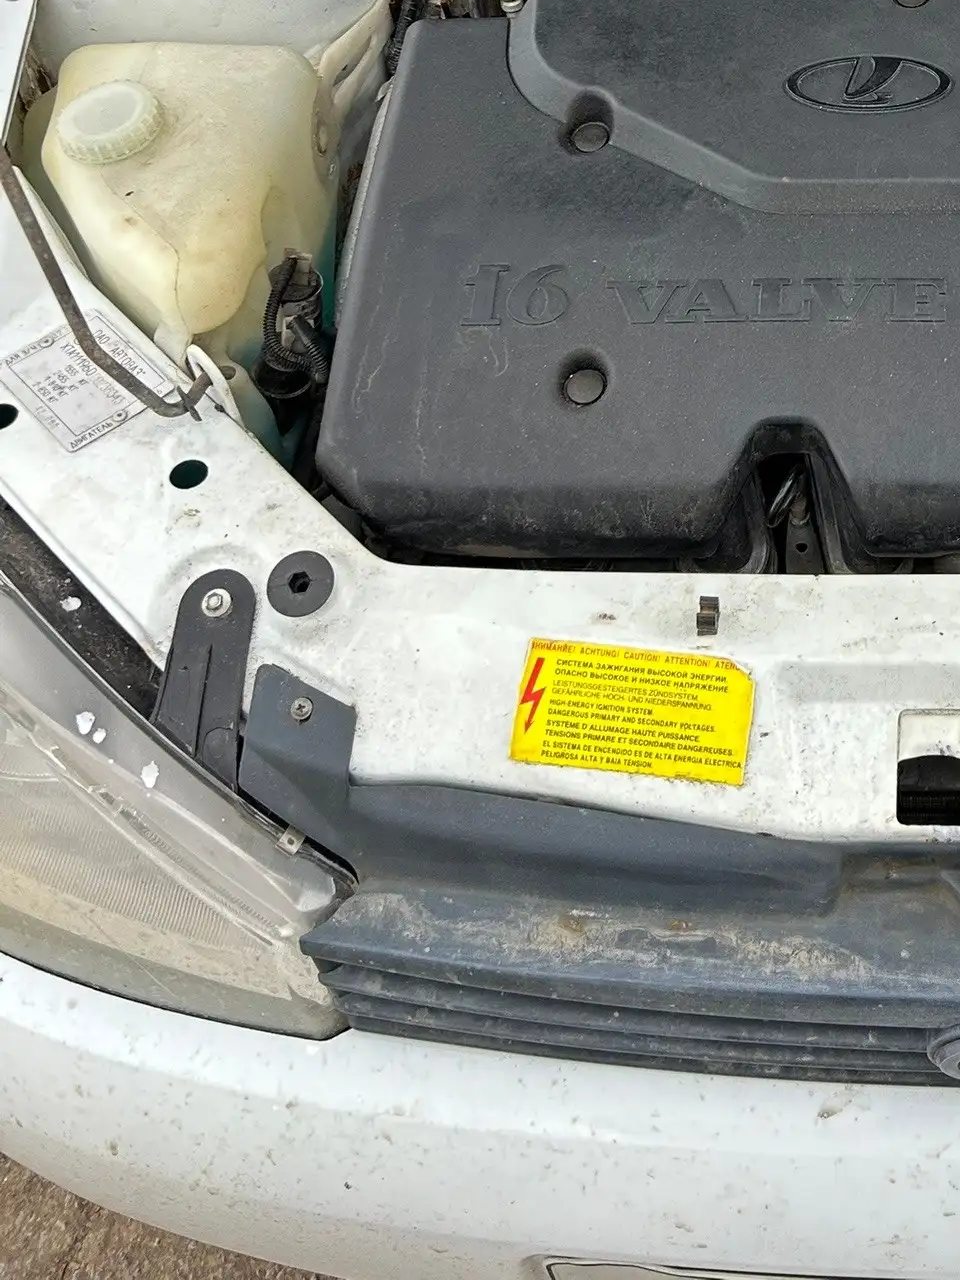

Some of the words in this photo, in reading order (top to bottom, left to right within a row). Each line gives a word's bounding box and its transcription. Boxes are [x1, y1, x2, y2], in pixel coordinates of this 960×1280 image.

[461, 263, 569, 327] 16
[605, 277, 947, 324] VALVE
[556, 657, 593, 669] СИСТЕМА
[595, 662, 645, 675] ЗАЖИГАНИЯ
[646, 668, 687, 680] ВЫСОКОЙ
[579, 646, 619, 658] ACHTUNG!
[623, 651, 661, 663] CAUTION!
[664, 656, 711, 669] ATTENTION!
[552, 677, 647, 696] LEISTUNGSGESTEIGERTES
[554, 666, 588, 678] ОПАСНО
[589, 670, 629, 683] ВЫСОКОЕ
[631, 675, 637, 684] И
[639, 676, 670, 688] НИЗКОЕ
[595, 703, 625, 713] IGNITION
[627, 695, 643, 704] UND
[547, 706, 589, 719] DANGEROUS
[590, 711, 620, 723] PRIMARY
[621, 715, 635, 725] AND
[636, 717, 677, 730] SECONDARY
[544, 727, 581, 739] TENSIONS
[617, 736, 626, 744] ET
[628, 737, 675, 750] SECONDAIRE
[631, 728, 656, 738] HAUTE
[540, 749, 578, 760] PELIGROSA
[580, 753, 597, 763] ALTA
[542, 738, 551, 747] EL
[552, 740, 581, 751] SISTEMA
[593, 745, 632, 757] ENCENDIDO
[633, 749, 642, 758] ES
[643, 751, 653, 759] DE
[654, 752, 671, 762] ALTA
